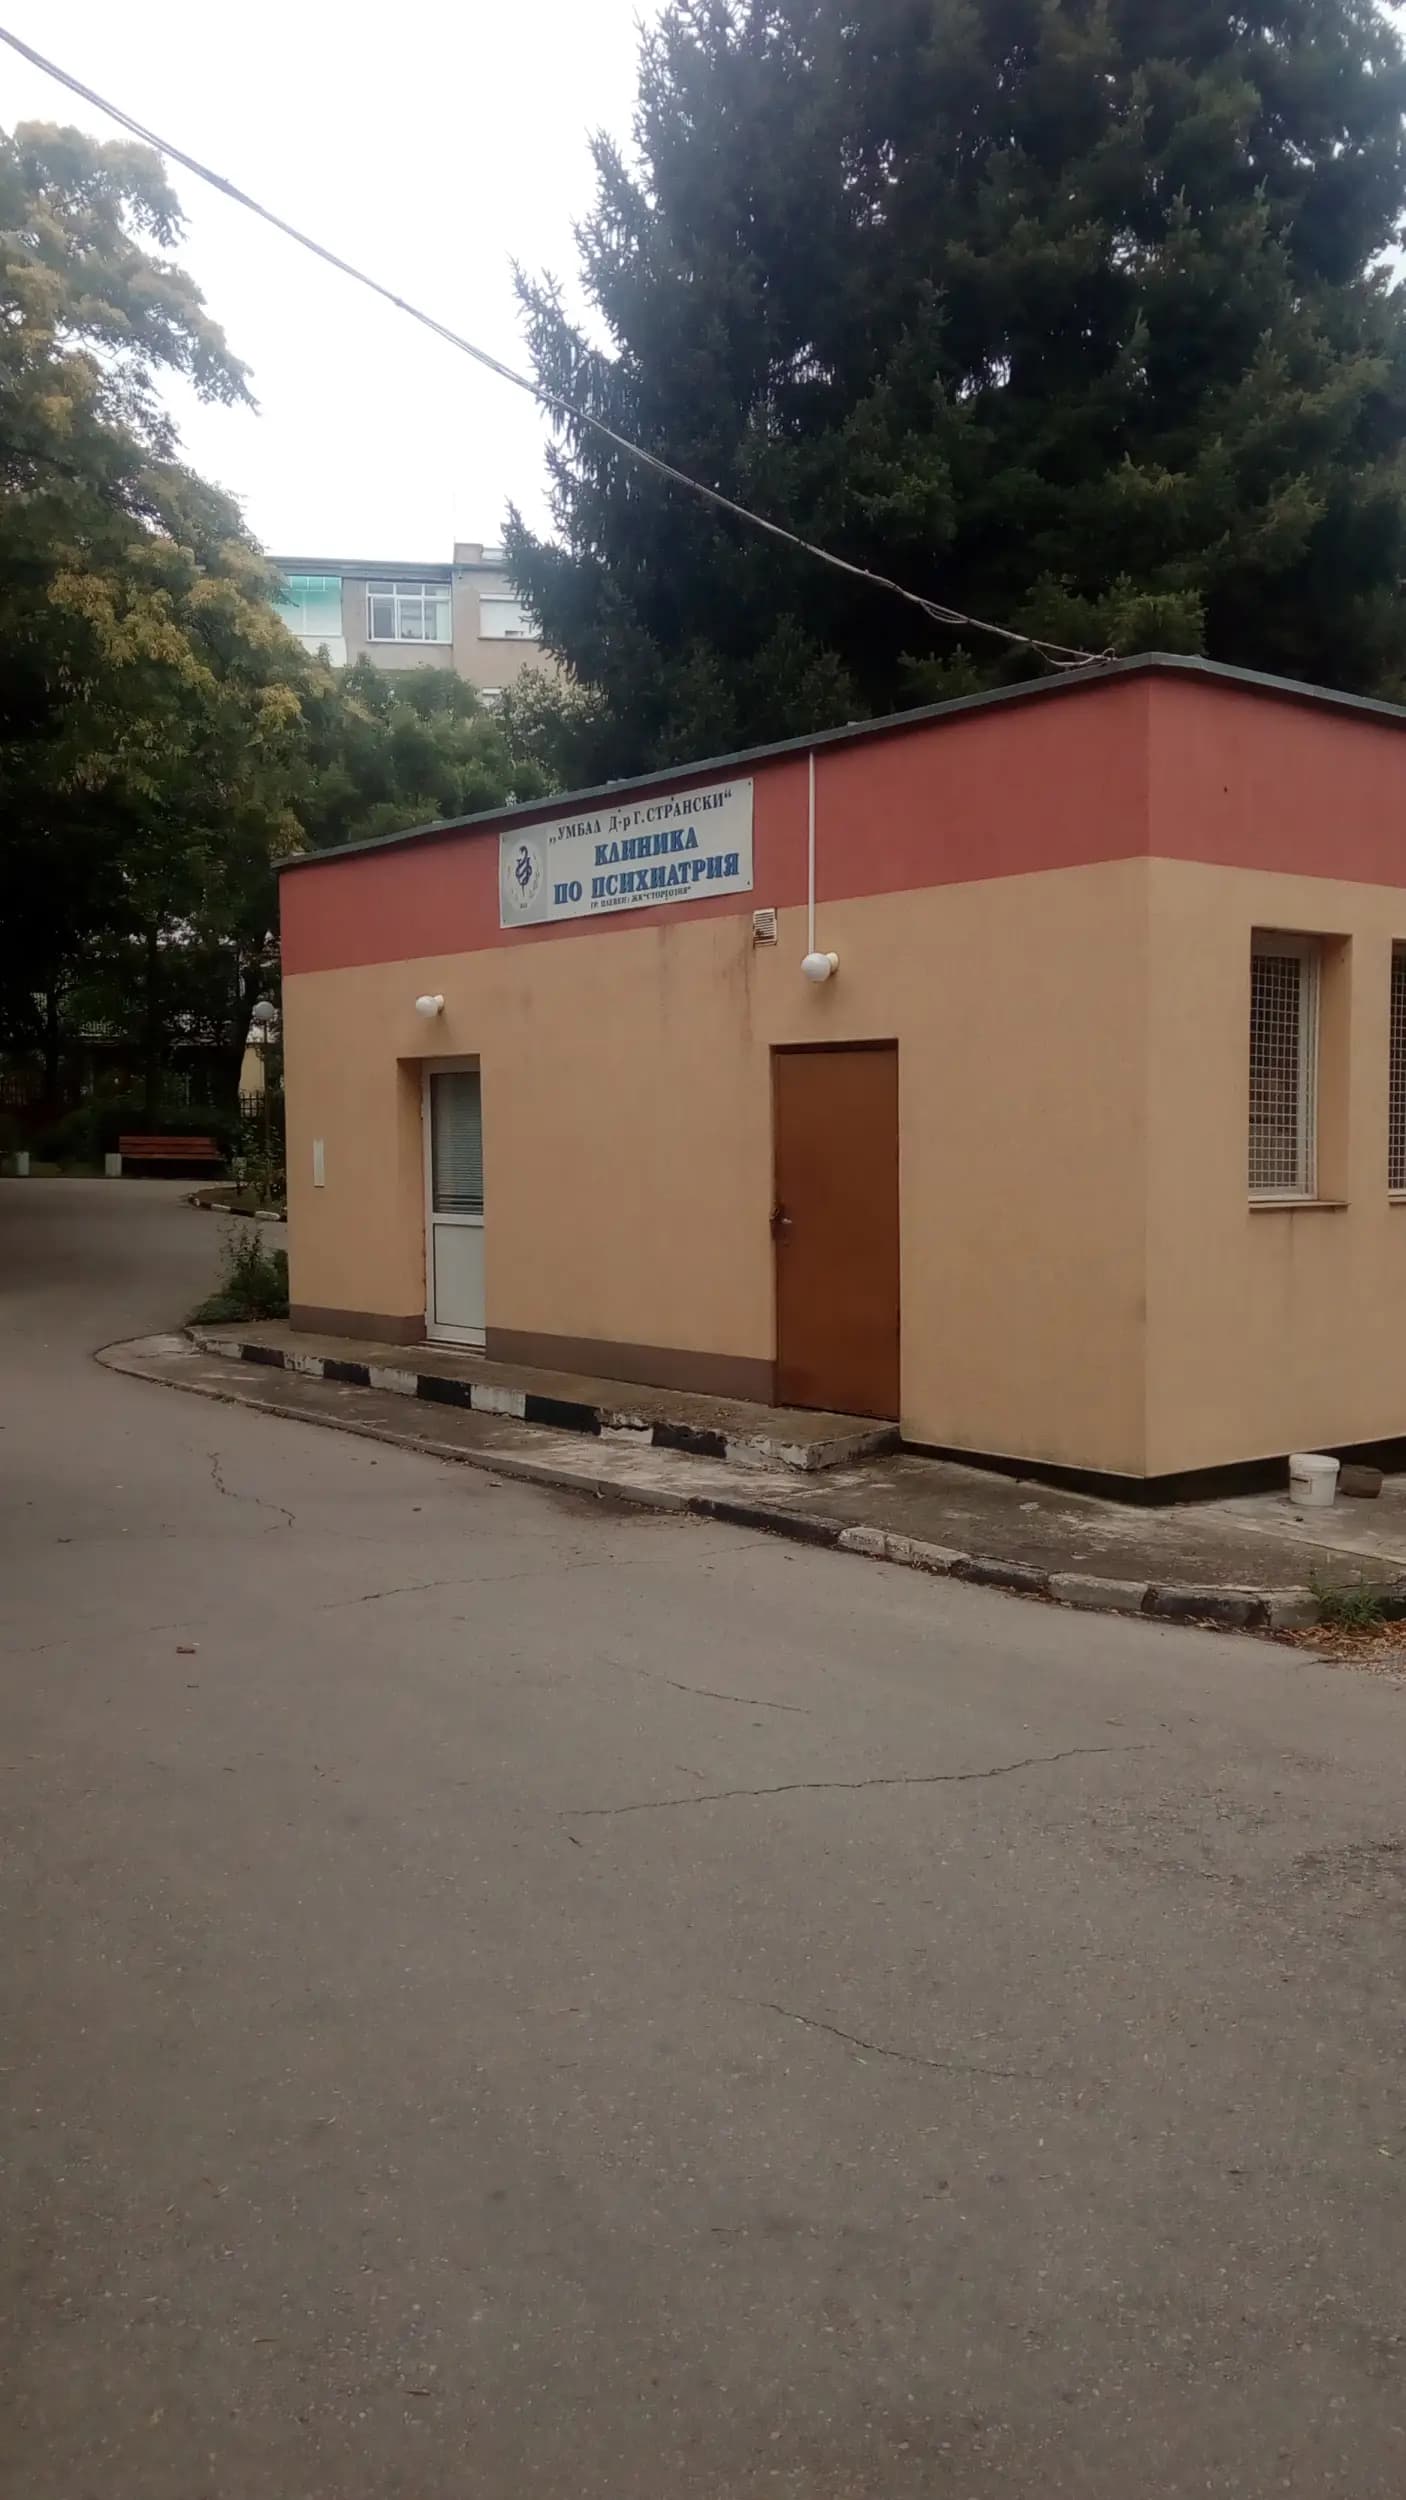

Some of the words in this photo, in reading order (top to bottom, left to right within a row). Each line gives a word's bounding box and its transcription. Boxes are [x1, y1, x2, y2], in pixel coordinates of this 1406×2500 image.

[609, 815, 631, 832] Д-р
[594, 827, 699, 866] КЛИНИКА
[554, 883, 583, 904] ПО
[591, 852, 739, 898] ПСИХИАТРИЯ
